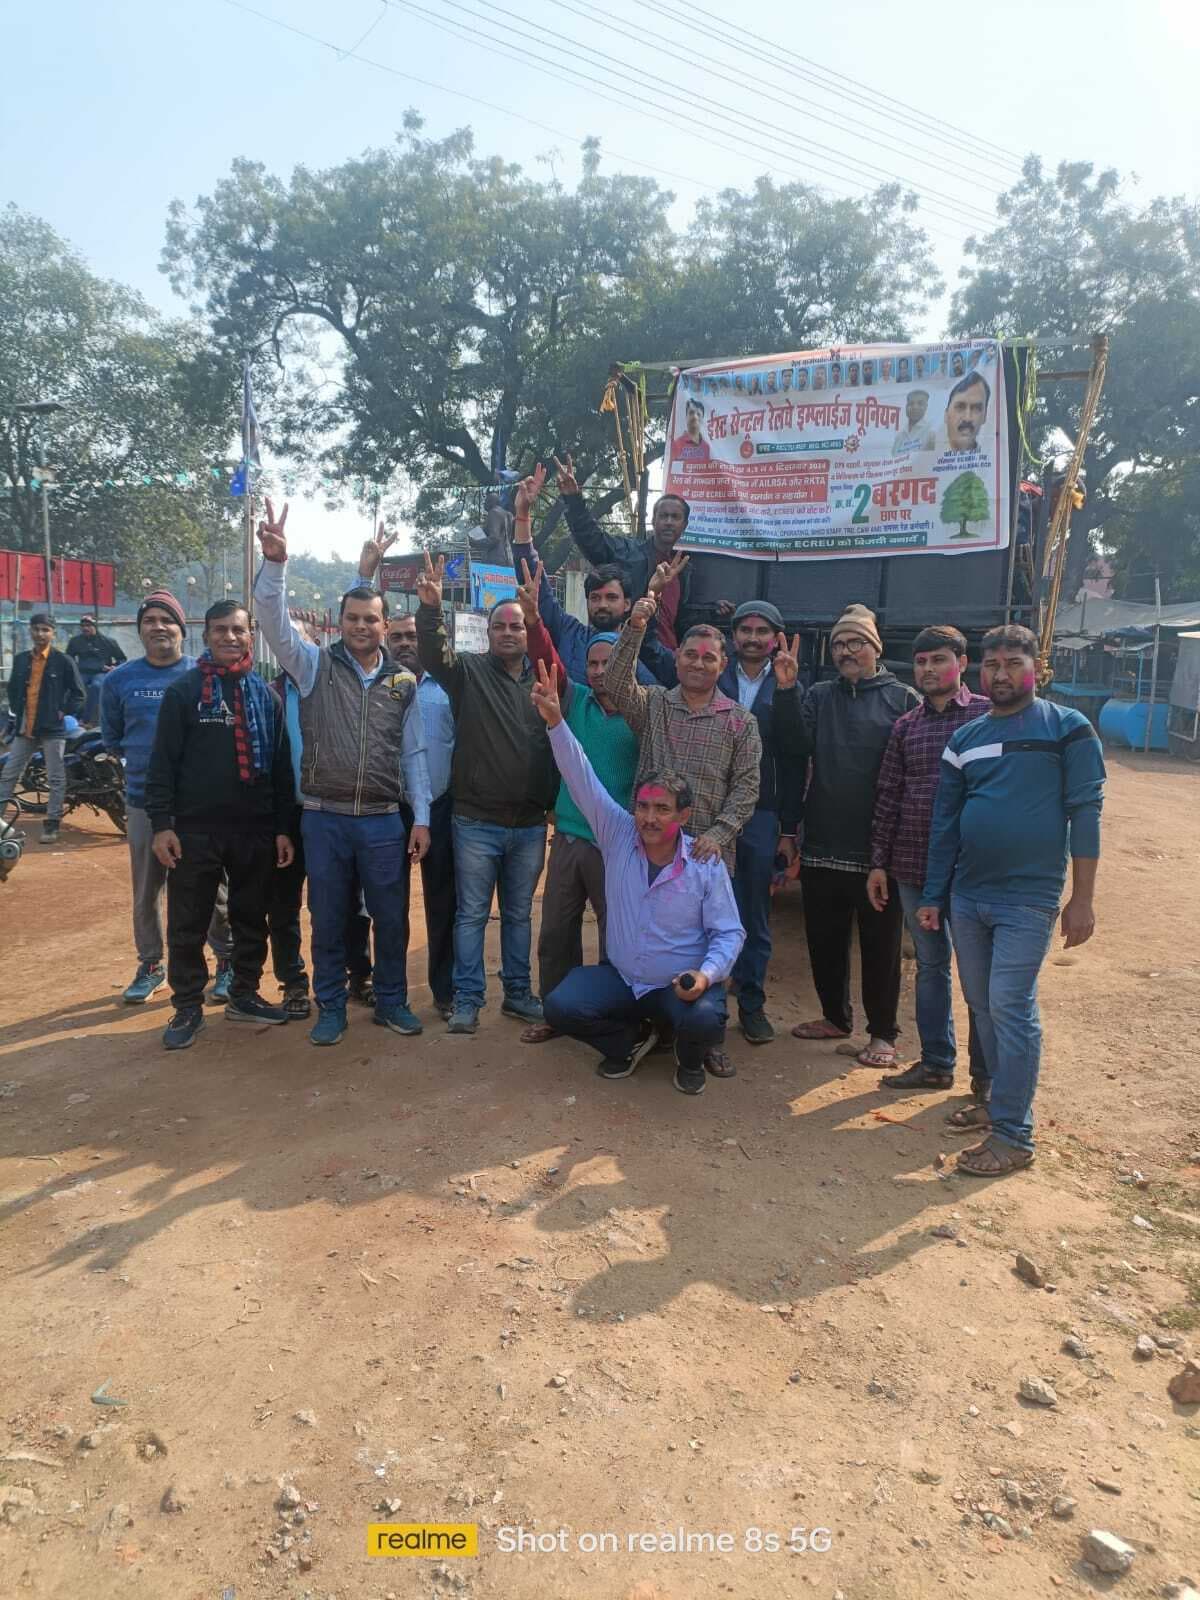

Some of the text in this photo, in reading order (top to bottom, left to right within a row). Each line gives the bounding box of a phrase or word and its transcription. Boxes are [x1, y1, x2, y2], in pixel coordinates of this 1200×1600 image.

[707, 408, 729, 440] ईस्ट
[730, 406, 766, 440] सेन्ट्रल
[766, 398, 794, 432] रेलवे
[856, 396, 901, 436] यूनियन
[852, 483, 871, 524] 2
[872, 477, 940, 507] बरगद
[880, 509, 913, 521] छाप पर
[794, 540, 835, 549] ECREU
